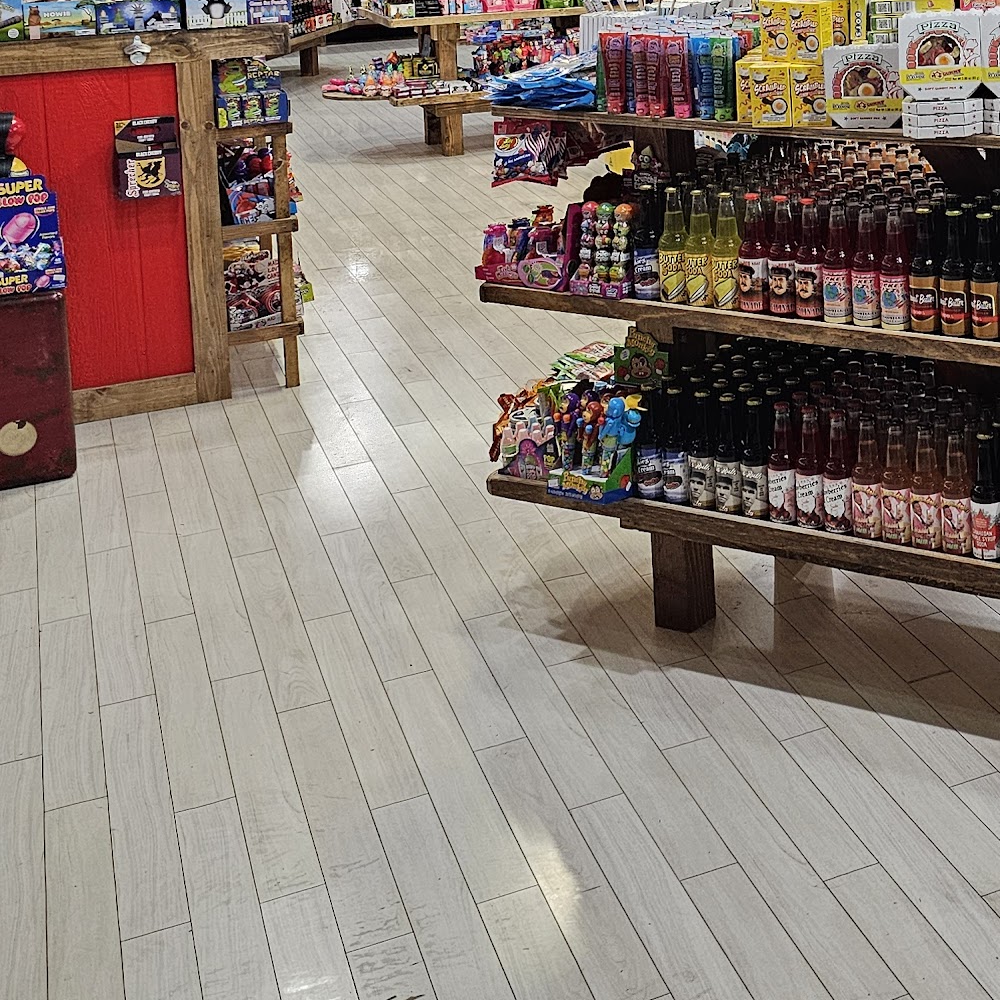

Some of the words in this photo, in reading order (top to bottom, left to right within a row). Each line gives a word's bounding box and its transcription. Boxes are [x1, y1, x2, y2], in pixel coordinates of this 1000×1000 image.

[854, 11, 863, 37] DOTS
[920, 21, 957, 31] Pizza
[845, 52, 880, 62] Pizza
[246, 69, 281, 79] REPTAR
[124, 159, 141, 198] Sprecher
[0, 179, 43, 196] SUPER
[0, 195, 25, 208] LOW
[26, 192, 48, 206] POP
[662, 261, 684, 276] SODA
[16, 284, 32, 293] POP
